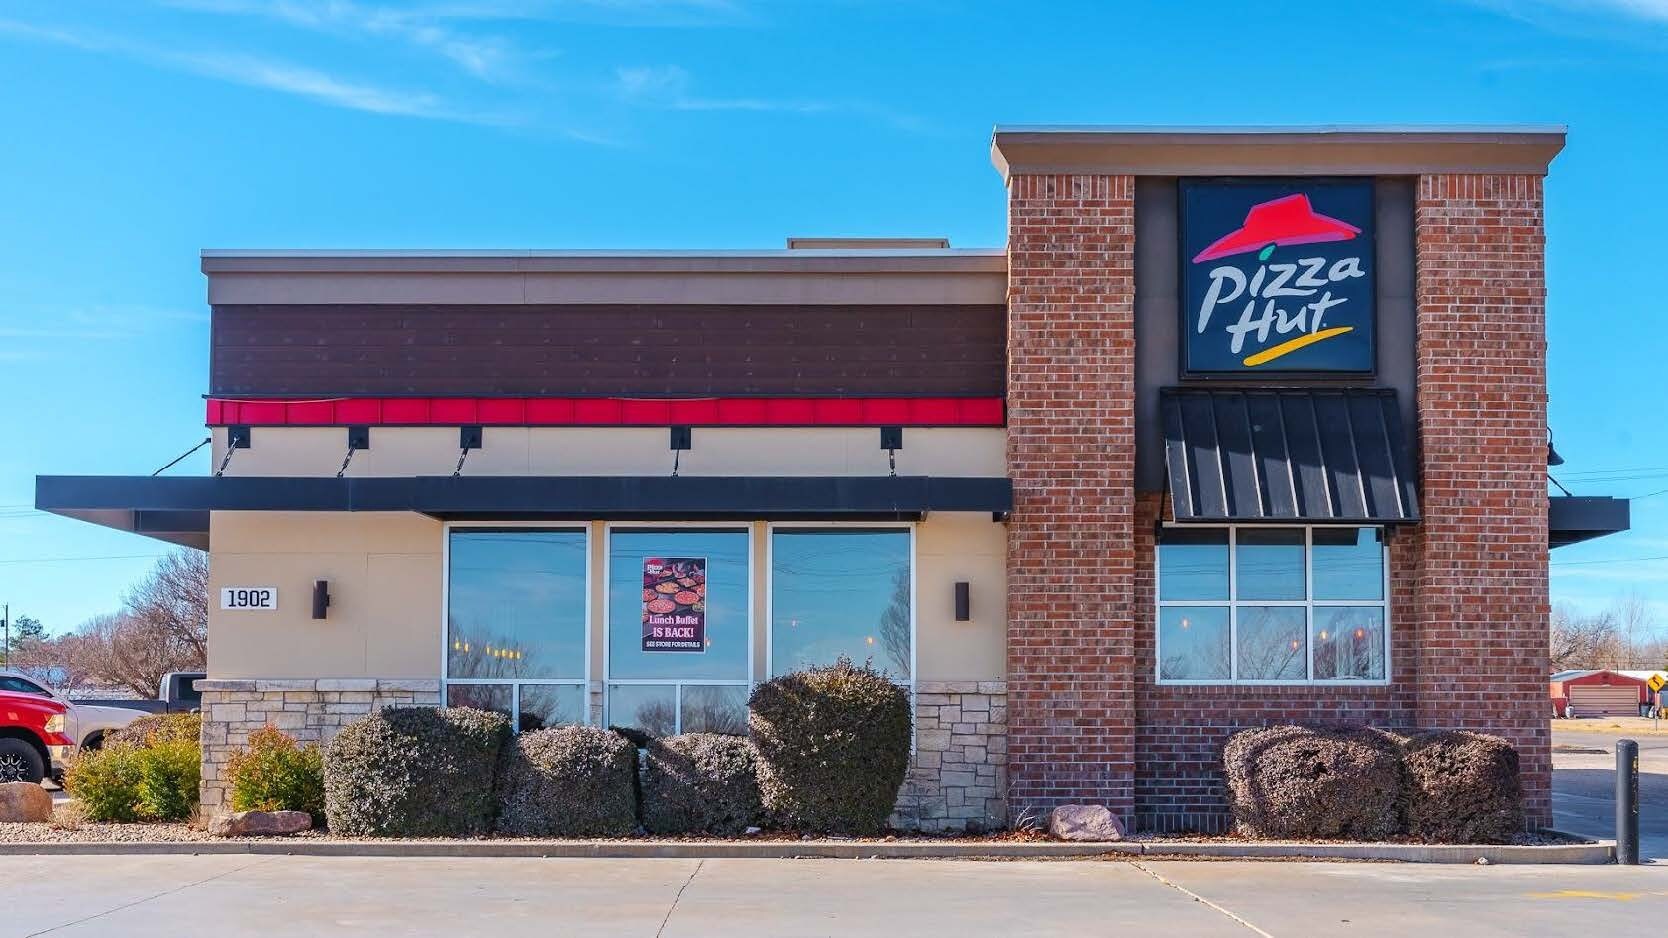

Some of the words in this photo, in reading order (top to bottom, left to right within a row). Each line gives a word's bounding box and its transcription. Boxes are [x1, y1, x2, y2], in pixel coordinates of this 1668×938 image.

[1198, 245, 1366, 333] Pizza
[1226, 291, 1348, 354] Hut
[228, 590, 270, 607] 1902
[649, 615, 674, 624] Lunch
[675, 615, 698, 624] Buffet
[653, 627, 663, 637] IS
[665, 627, 694, 637] BACK!
